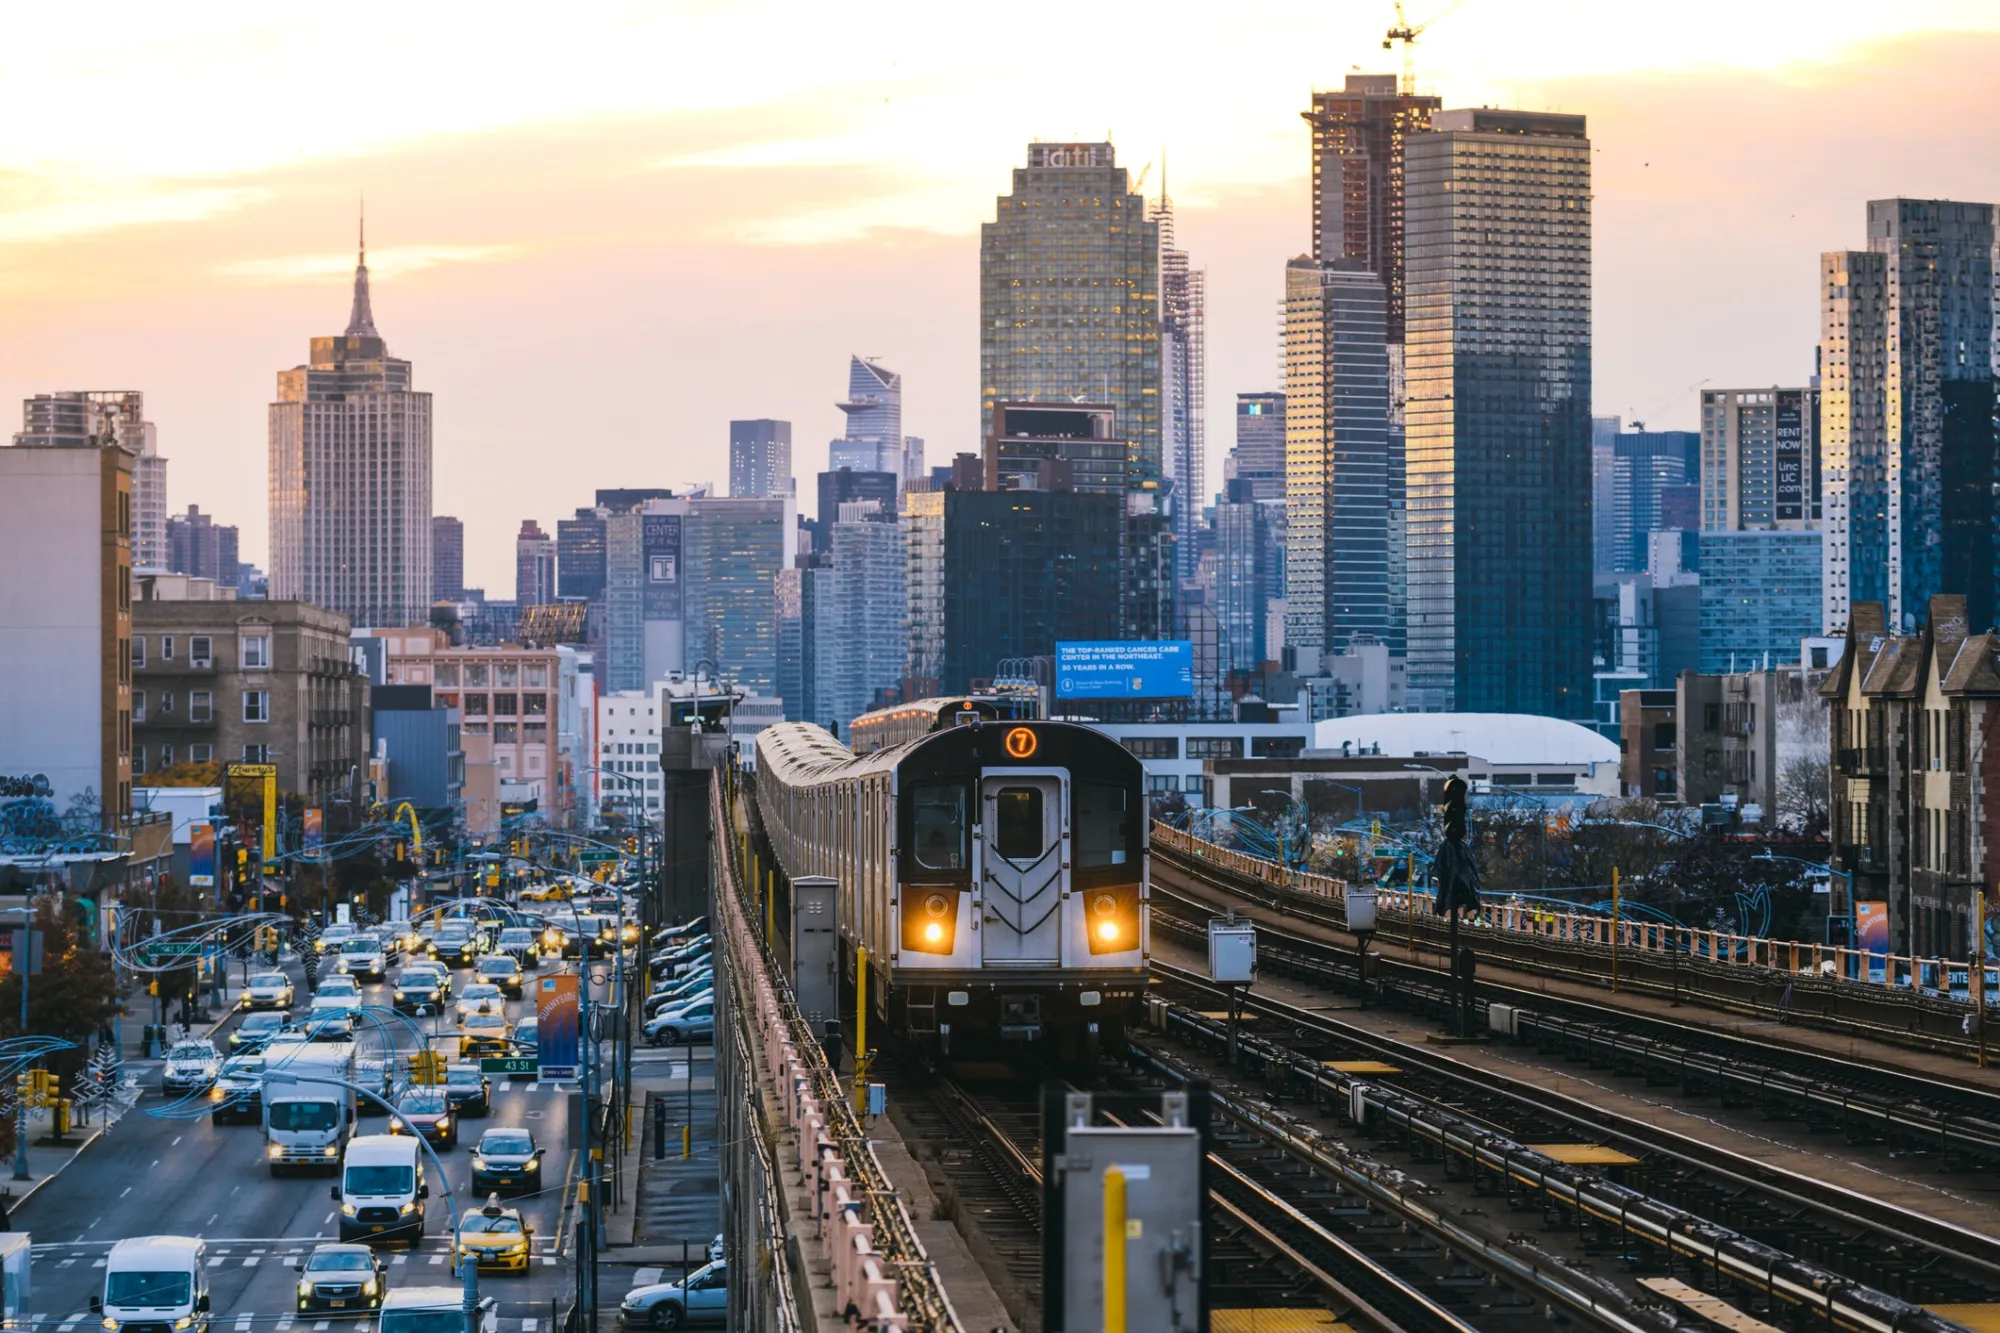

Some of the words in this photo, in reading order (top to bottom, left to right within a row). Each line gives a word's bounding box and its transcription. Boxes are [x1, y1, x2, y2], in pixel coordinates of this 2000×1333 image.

[1050, 146, 1089, 168] citi
[1777, 427, 1801, 437] RENT
[1777, 440, 1801, 450] NOW
[1779, 461, 1799, 471] Linc
[1777, 485, 1802, 493] .com
[645, 524, 680, 536] CENTER
[1077, 646, 1126, 654] TOP-RANKED
[1159, 645, 1180, 653] CARE
[538, 991, 577, 1021] SUNNYSIDE
[505, 1061, 516, 1070] 43
[520, 1061, 529, 1070] St
